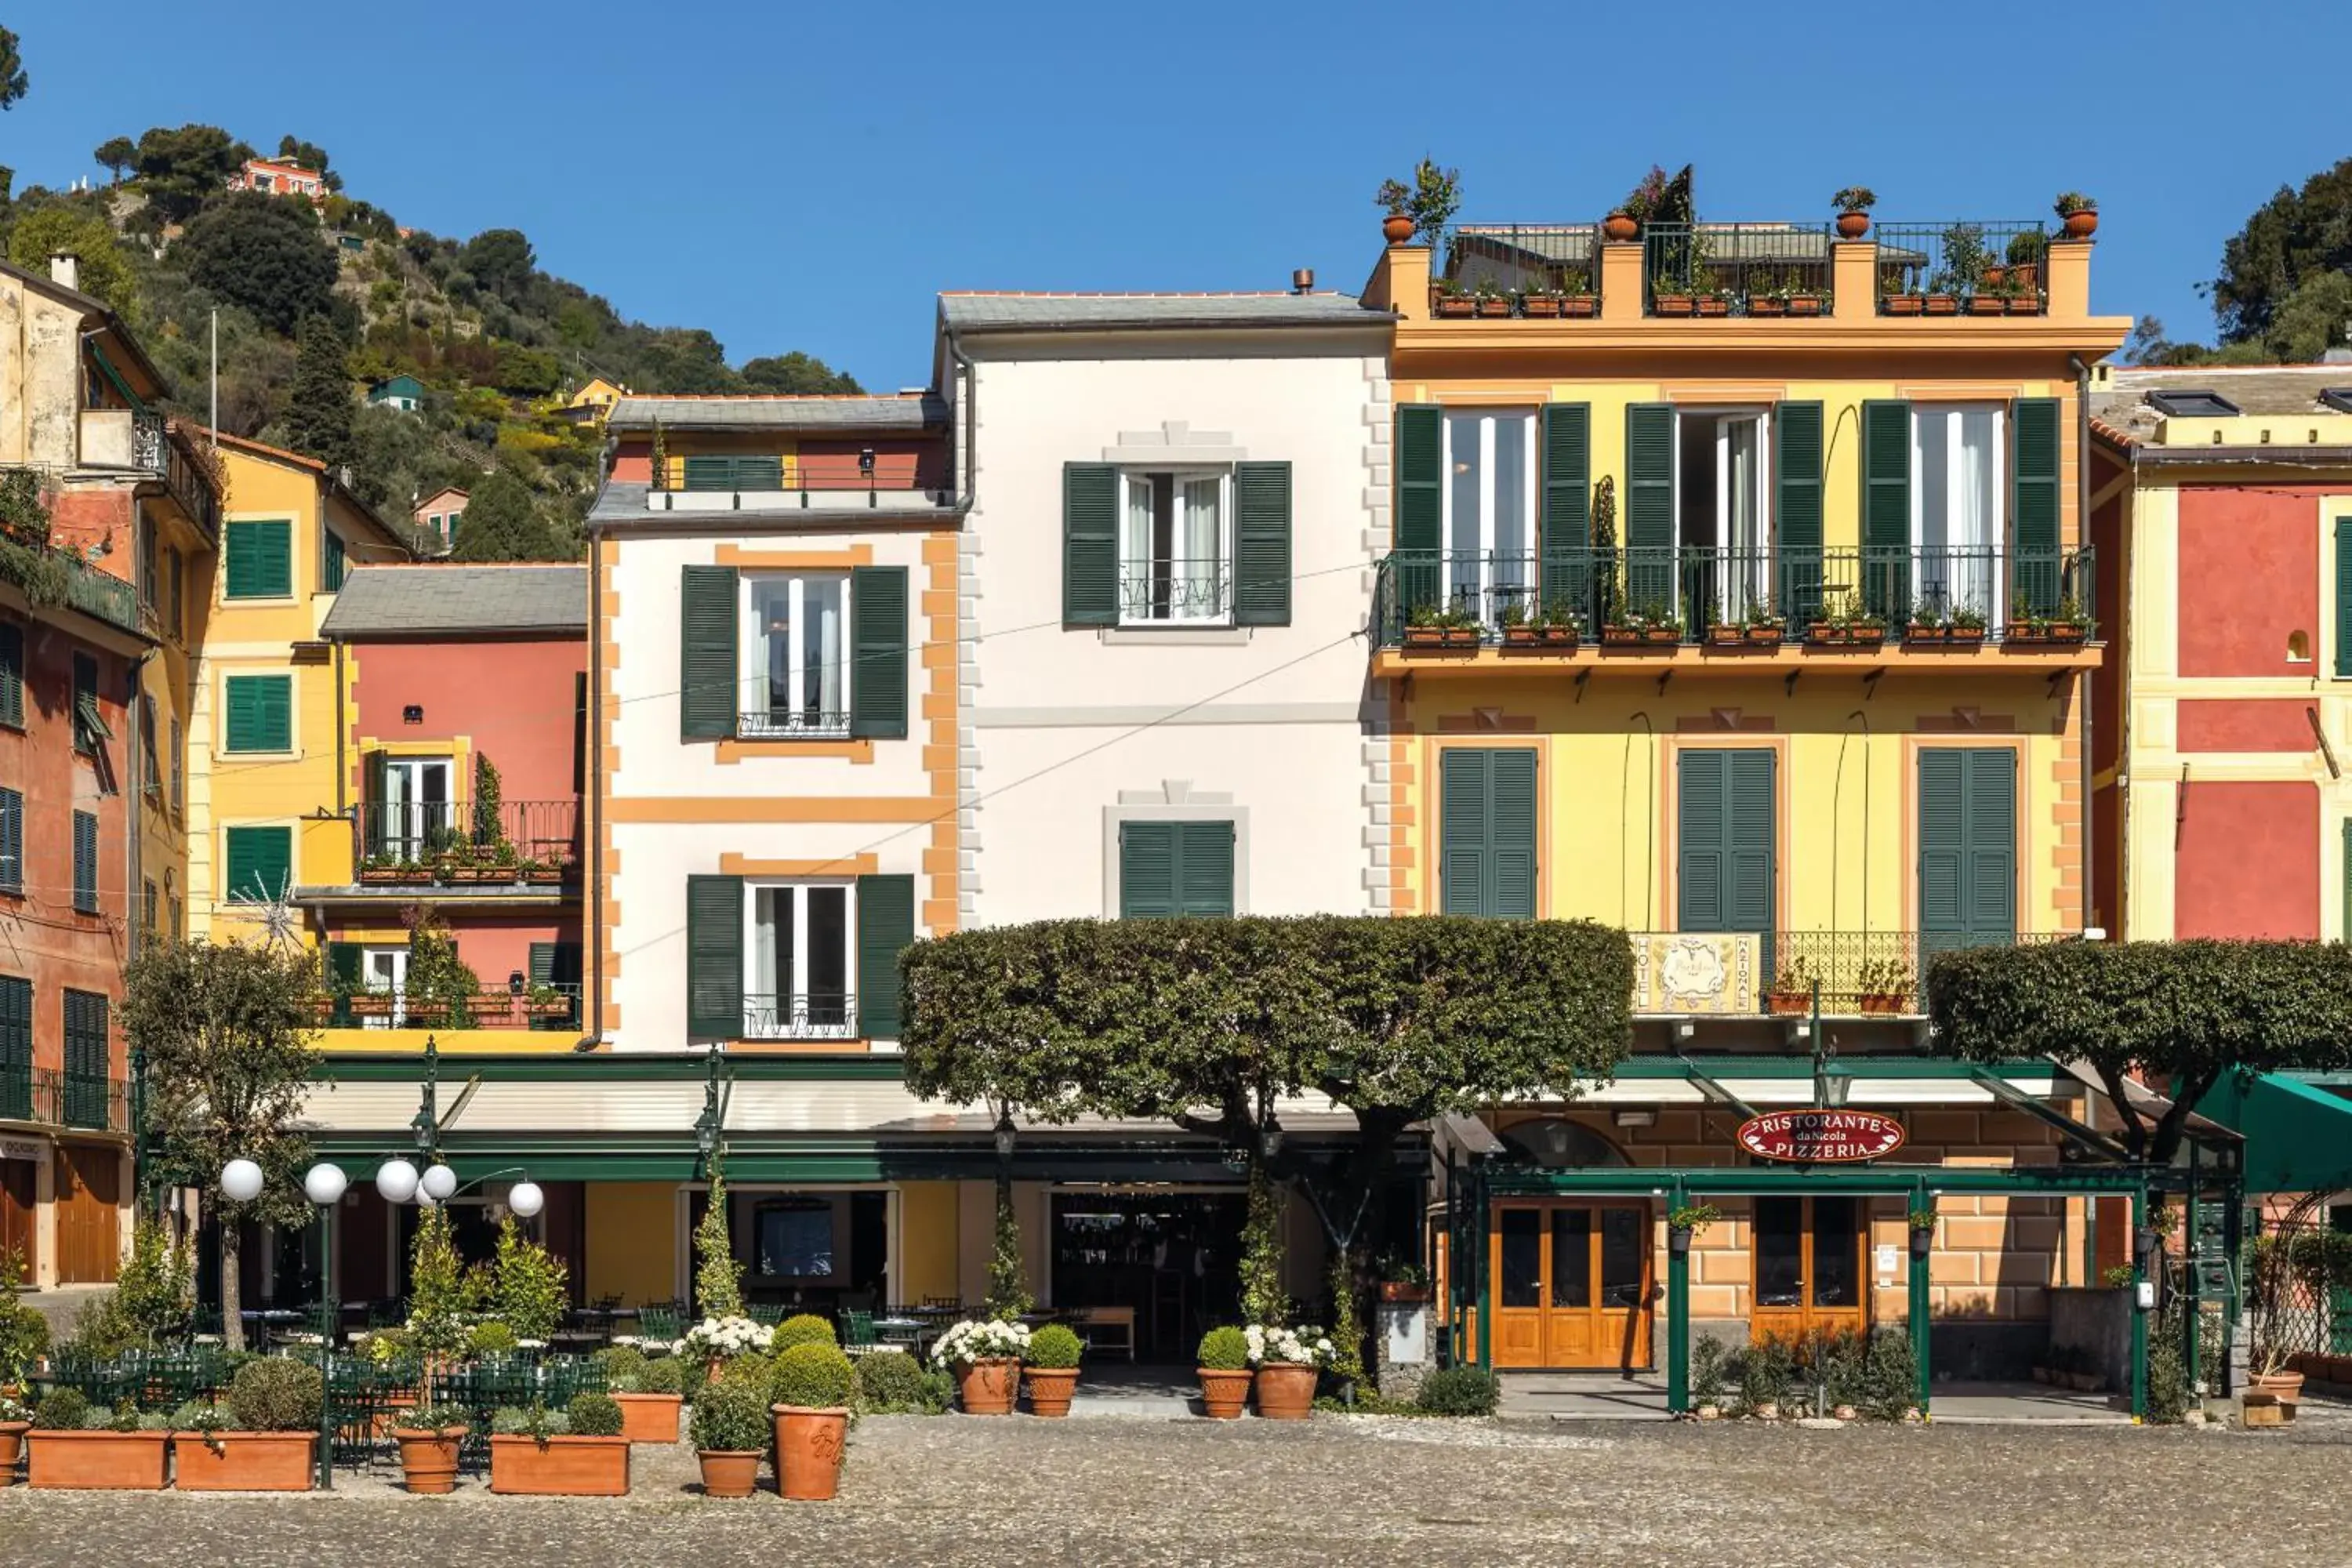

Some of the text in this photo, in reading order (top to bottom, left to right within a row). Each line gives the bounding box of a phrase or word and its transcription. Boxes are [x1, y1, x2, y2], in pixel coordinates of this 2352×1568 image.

[1638, 940, 1649, 1007] HOTEL
[1738, 940, 1748, 1007] NAZIONALE
[1762, 1115, 1881, 1134] RISTORANTE
[1797, 1131, 1846, 1142] da Nicola
[1776, 1142, 1868, 1158] PIZZERIA
